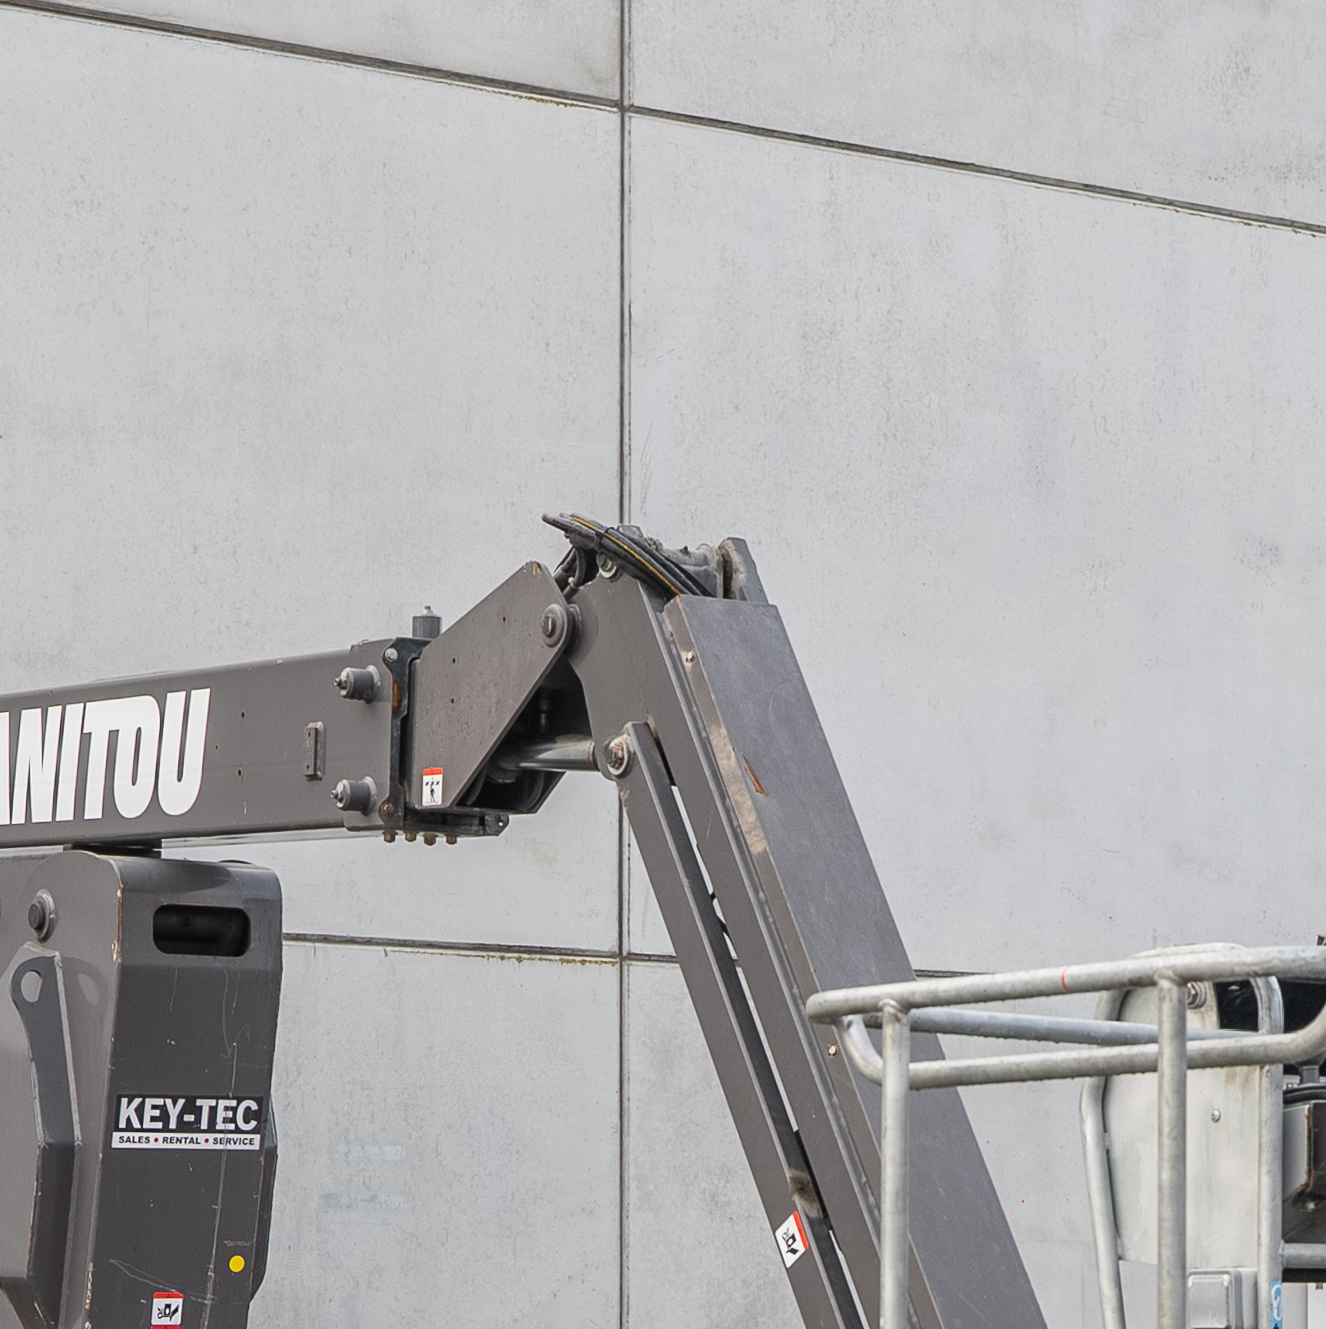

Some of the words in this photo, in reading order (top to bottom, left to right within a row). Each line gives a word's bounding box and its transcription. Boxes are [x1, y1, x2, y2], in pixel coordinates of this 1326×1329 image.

[118, 1097, 259, 1131] KEY-TEC
[118, 1135, 151, 1144] SALES
[162, 1136, 201, 1145] RENTAL
[212, 1137, 255, 1146] SERVICE
